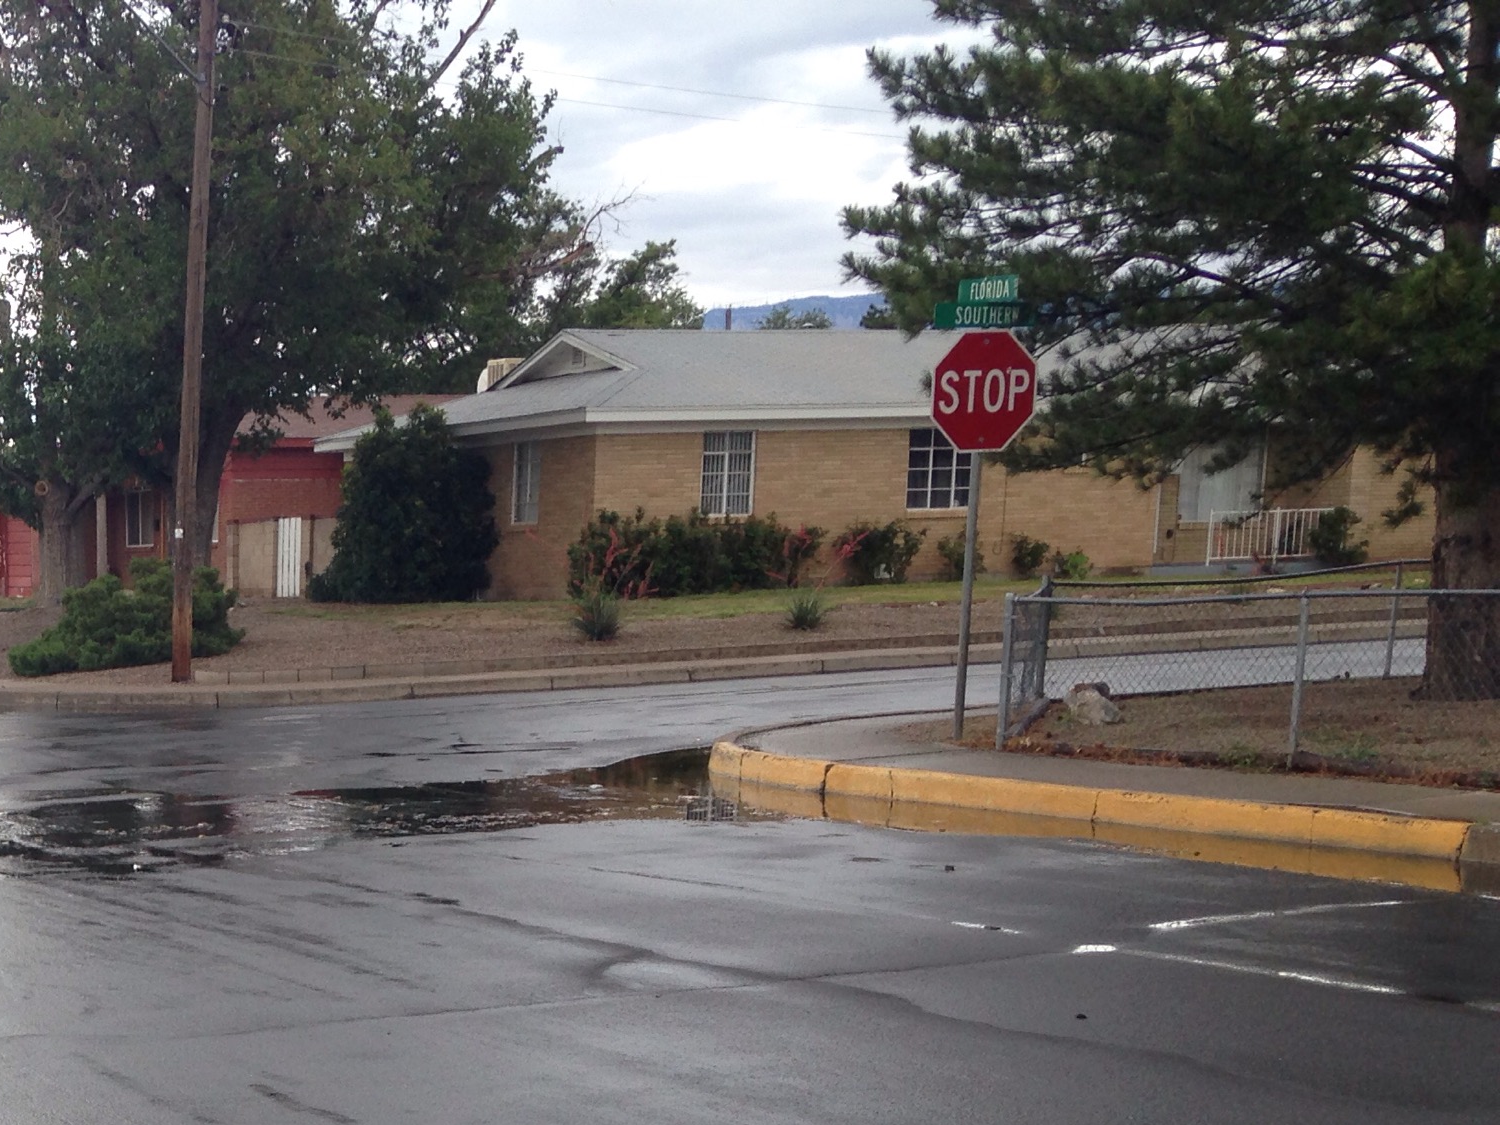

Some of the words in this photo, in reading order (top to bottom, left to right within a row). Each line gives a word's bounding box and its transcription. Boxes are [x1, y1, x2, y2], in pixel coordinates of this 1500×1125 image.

[970, 279, 1010, 300] FLORIDA
[955, 305, 1020, 325] SOUTHERN
[938, 367, 1030, 415] STOP
